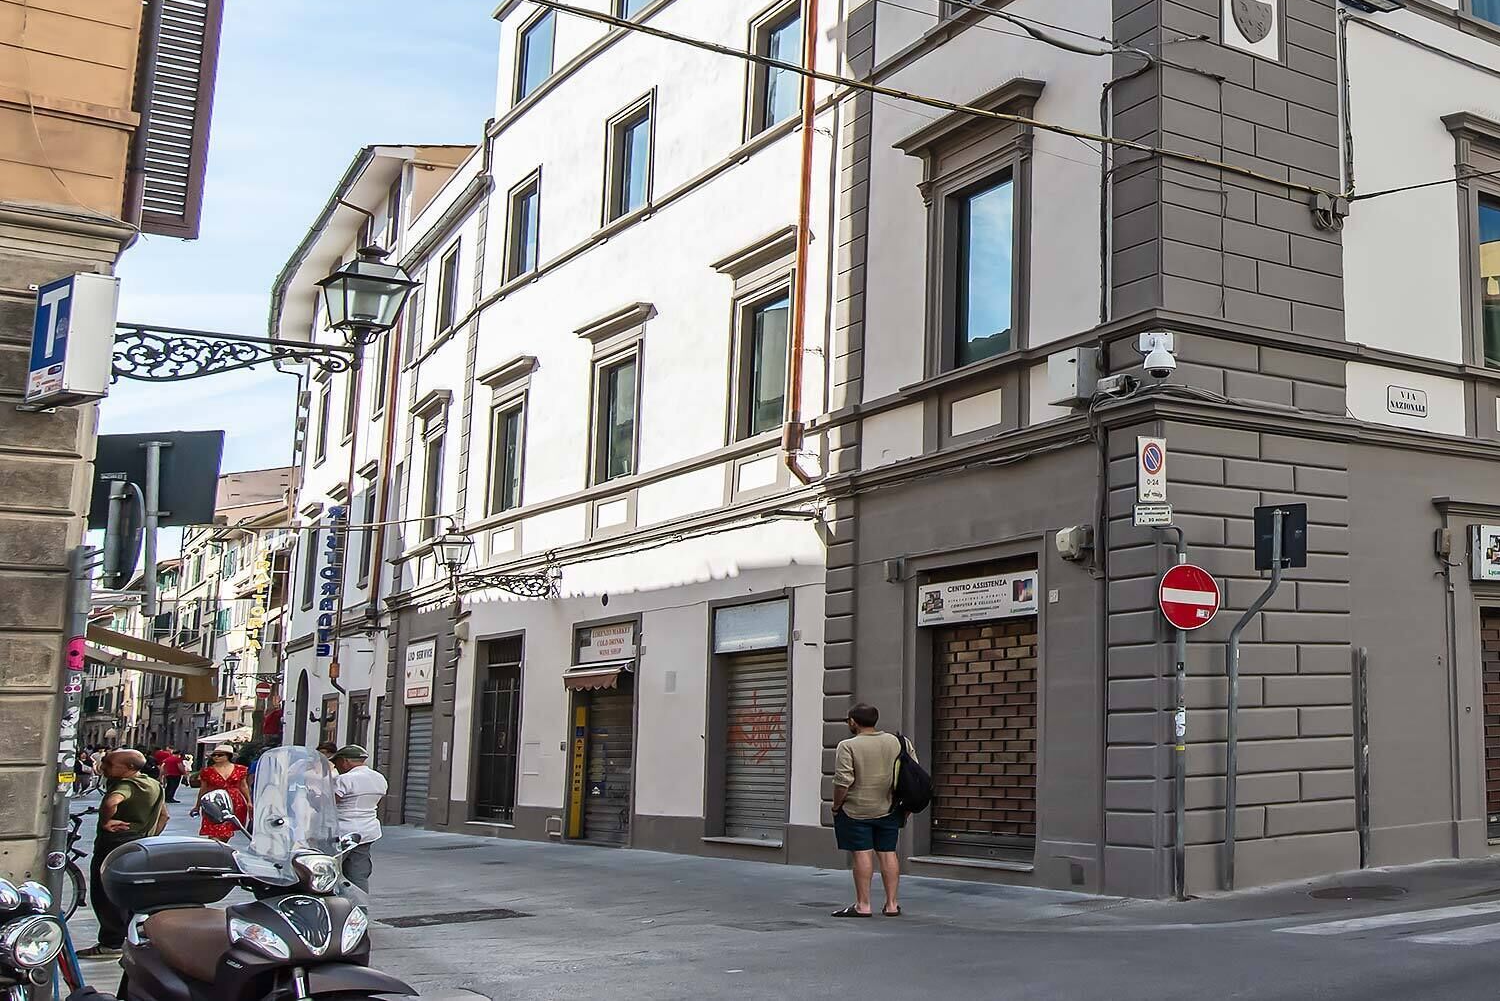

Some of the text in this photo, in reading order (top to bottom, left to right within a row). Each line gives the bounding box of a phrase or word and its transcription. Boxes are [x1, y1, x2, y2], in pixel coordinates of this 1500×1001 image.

[41, 284, 70, 359] T
[1400, 390, 1416, 401] VIA
[1390, 400, 1426, 413] NAZIONALE
[947, 583, 971, 594] CENTRO
[972, 579, 1007, 590] ASSISTENZA
